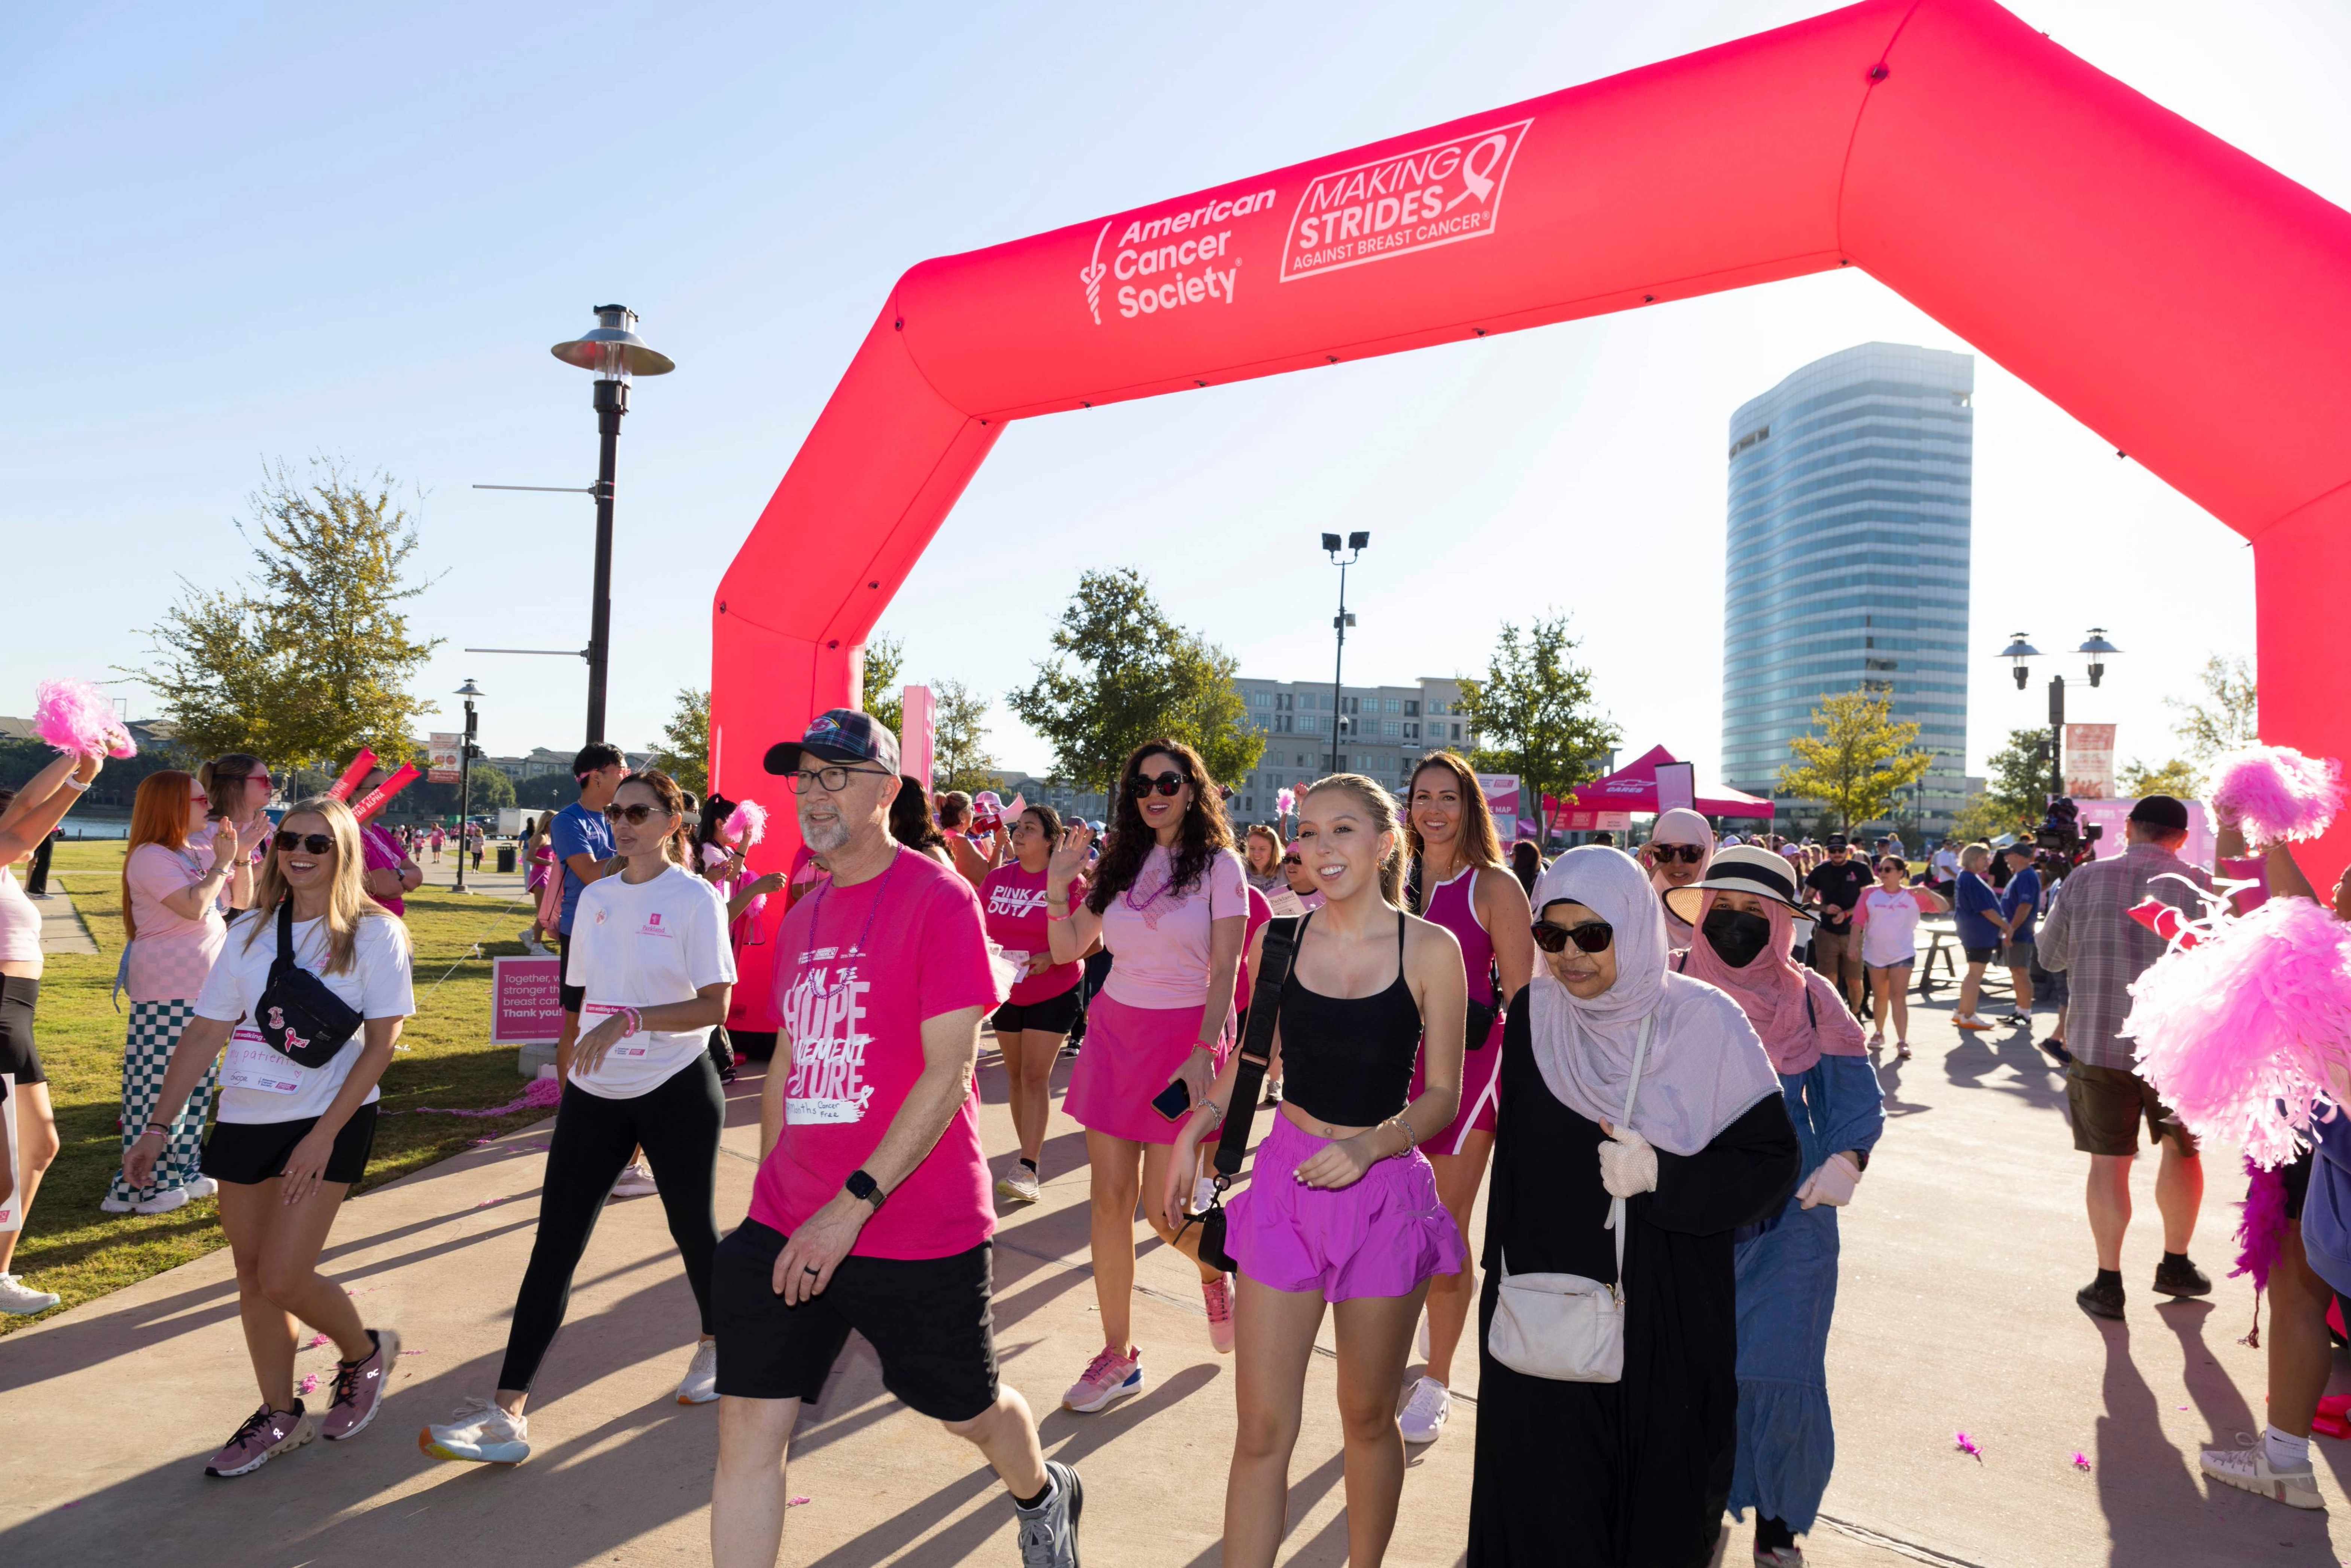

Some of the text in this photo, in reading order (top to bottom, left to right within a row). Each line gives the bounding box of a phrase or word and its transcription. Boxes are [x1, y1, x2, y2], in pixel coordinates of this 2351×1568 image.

[1309, 146, 1461, 213] MAKING
[1118, 189, 1276, 247] American
[1299, 185, 1444, 249] STRIDES
[1114, 230, 1231, 281] Cancer
[1293, 243, 1353, 271] AGAINST
[1358, 228, 1413, 255] BREAST
[354, 807, 366, 818] TAU
[367, 791, 386, 809] ALPHA
[993, 885, 1033, 900] PINK
[1270, 893, 1295, 904] Parkland
[988, 900, 1021, 916] OUT
[504, 974, 550, 985] Together,
[503, 986, 547, 996] stronger
[503, 998, 537, 1006] breast
[503, 1008, 562, 1019] Thank you!
[783, 981, 871, 1042] HOPE
[817, 1100, 840, 1109] Cancer
